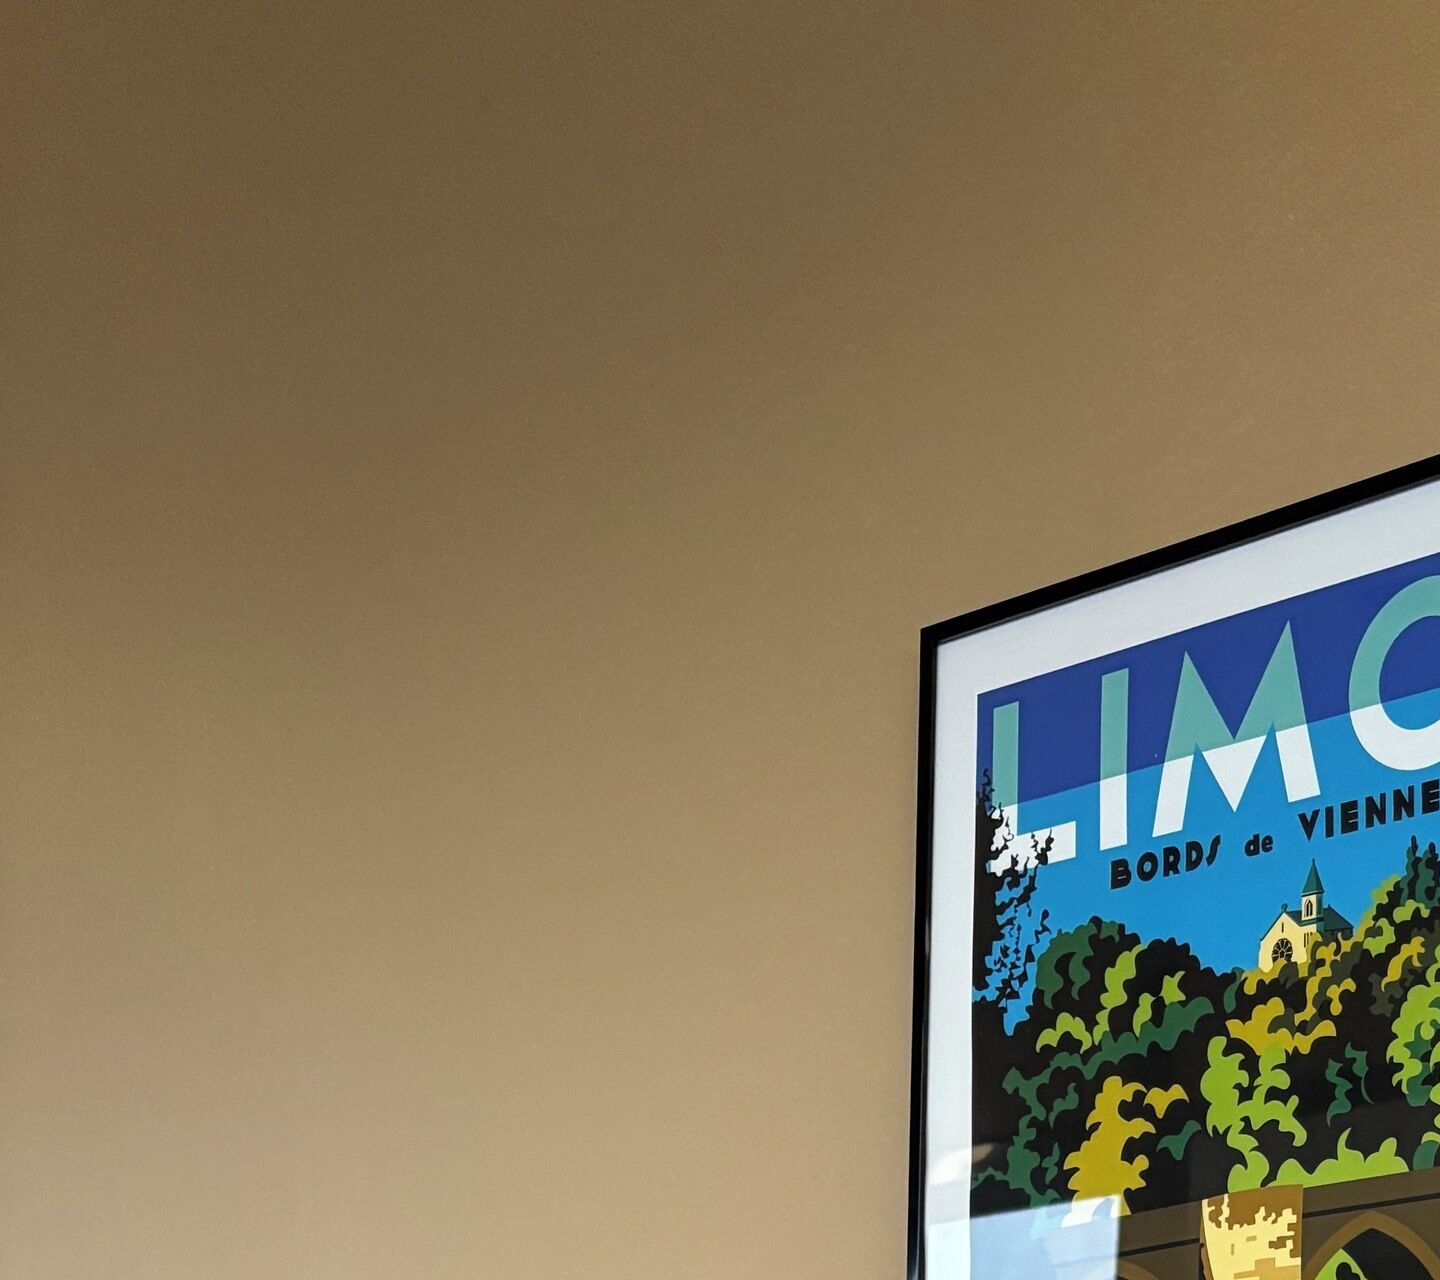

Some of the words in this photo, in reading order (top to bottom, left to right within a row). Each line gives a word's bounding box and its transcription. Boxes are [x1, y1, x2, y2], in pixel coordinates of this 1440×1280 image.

[1110, 834, 1221, 890] BORDS
[1244, 833, 1274, 857] de
[1298, 778, 1440, 841] VIENNE
